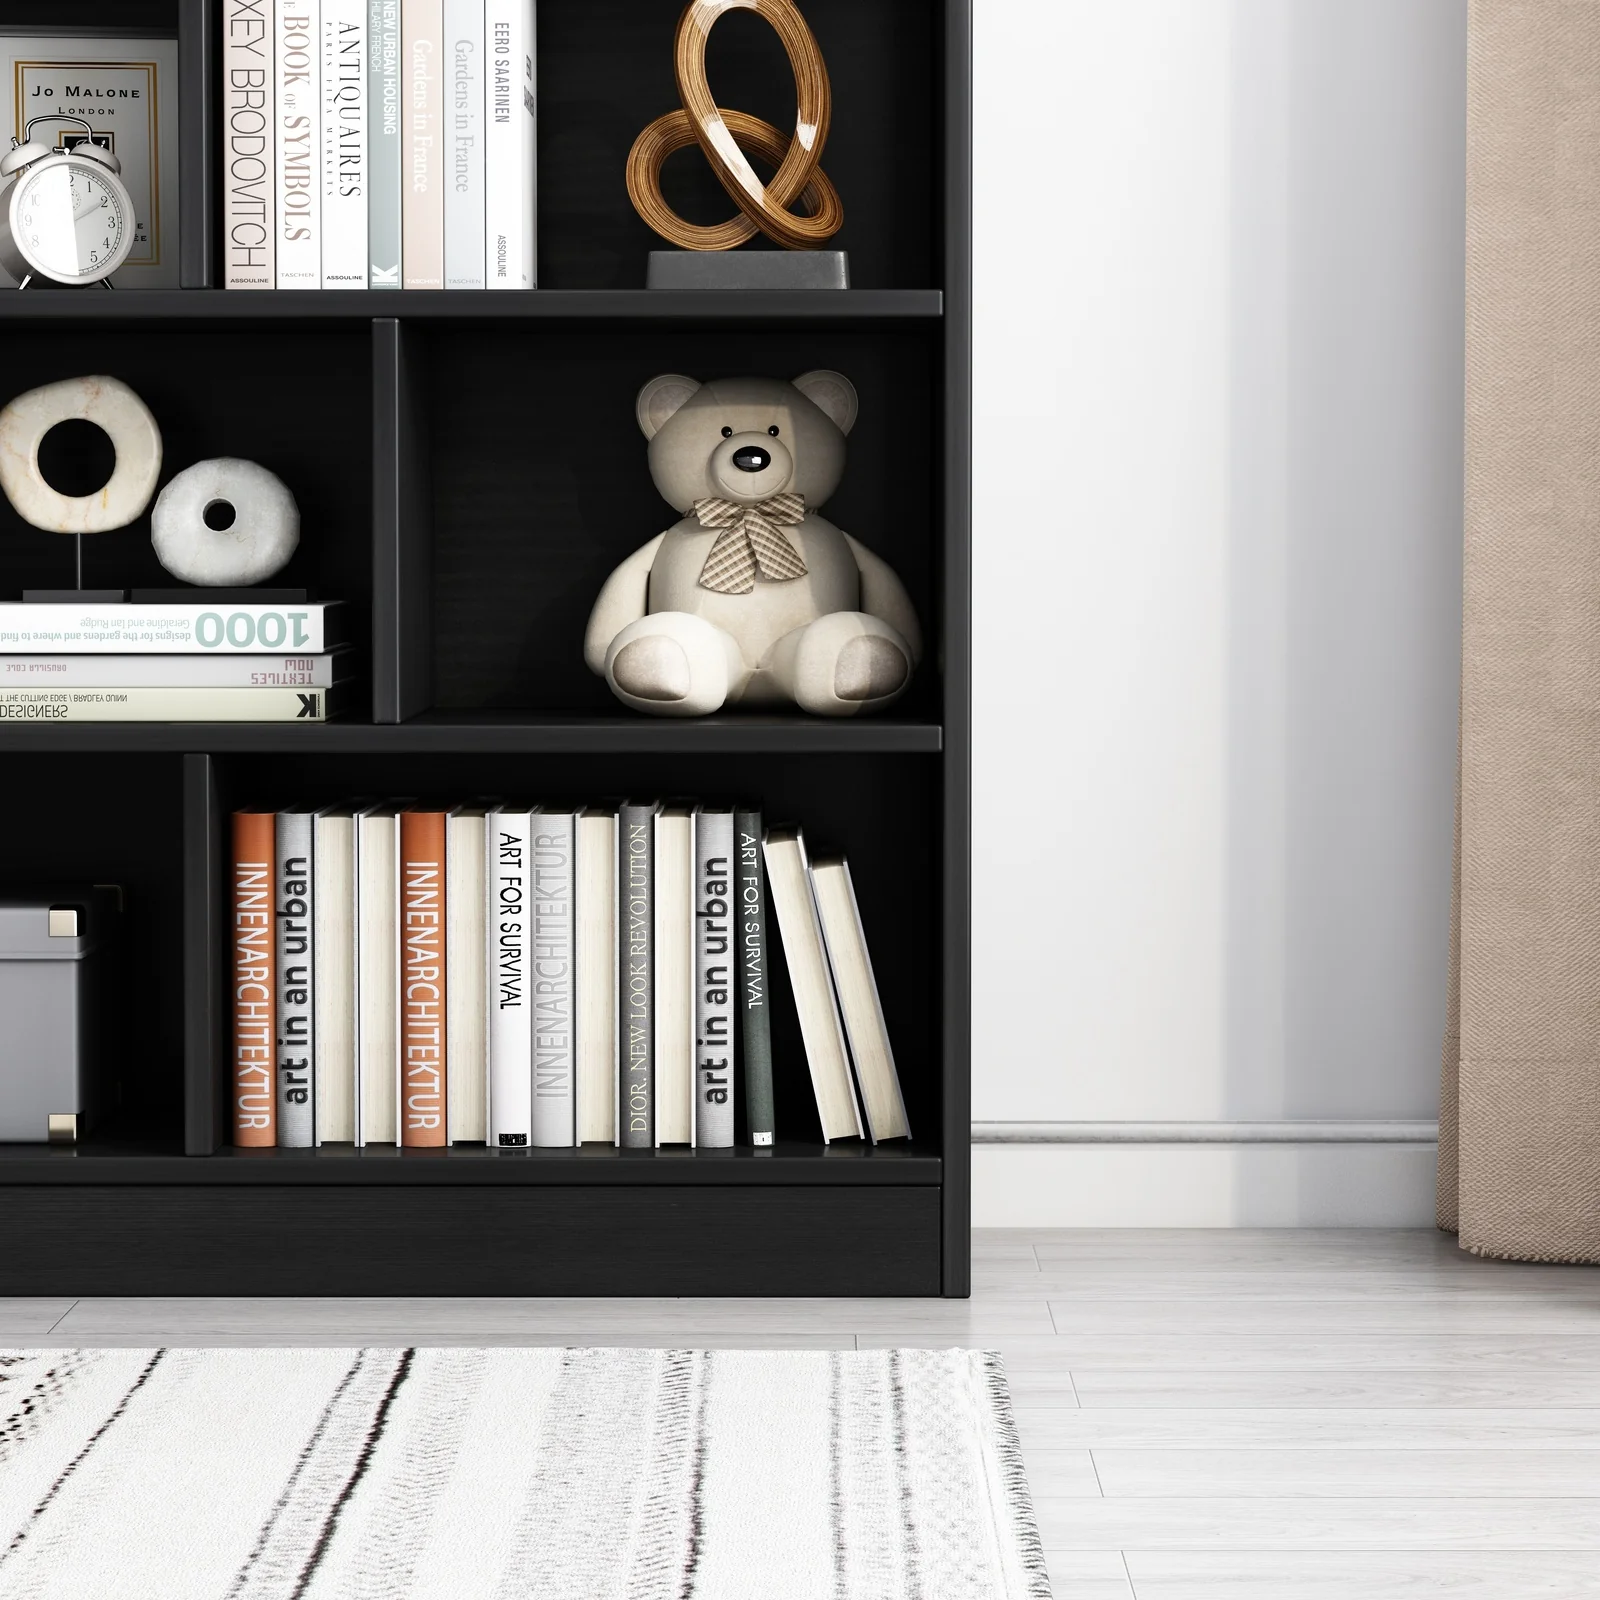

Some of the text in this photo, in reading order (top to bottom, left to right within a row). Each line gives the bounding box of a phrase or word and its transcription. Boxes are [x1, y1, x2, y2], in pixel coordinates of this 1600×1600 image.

[283, 16, 311, 87] BOOK
[325, 22, 333, 67] PARIS
[371, 1, 381, 72] HILARY FRENCH
[383, 1, 397, 135] NEW URBAN HOUSING
[65, 86, 140, 98] MALONE
[283, 93, 297, 110] OF
[494, 22, 510, 123] EERO SAARINEN
[58, 107, 115, 115] LONDON
[333, 21, 362, 197] ANTIQUAIRES
[412, 39, 433, 193] Gardens in France
[454, 39, 475, 193] Gardens in France
[100, 195, 108, 208] 2
[230, 69, 267, 267] BRODOVITCH
[283, 115, 311, 241] SYMBOLS
[90, 250, 98, 263] 5
[102, 237, 111, 249] 4
[107, 216, 116, 229] 3
[497, 234, 507, 278] ASSOULINE
[1, 630, 191, 643] designs for the gardens and where to find
[80, 617, 190, 629] Geraldine and Ian Rudge
[195, 612, 310, 648] 1000
[251, 673, 314, 685] TEXTILES
[296, 693, 317, 717] K
[499, 832, 522, 1010] ART FOR SURVIVAL
[740, 832, 763, 1009] ART FOR SURVIVAL
[236, 862, 270, 1129] INNENARCHITEKTUR
[276, 857, 309, 1104] art in an urban
[406, 862, 440, 1129] INNENARCHITEKTUR
[534, 833, 568, 1098] INNENARCHITEKTUR
[630, 824, 647, 1133] DIOR. NEW LOOK REVOLUTION
[697, 857, 728, 1105] art in an urban
